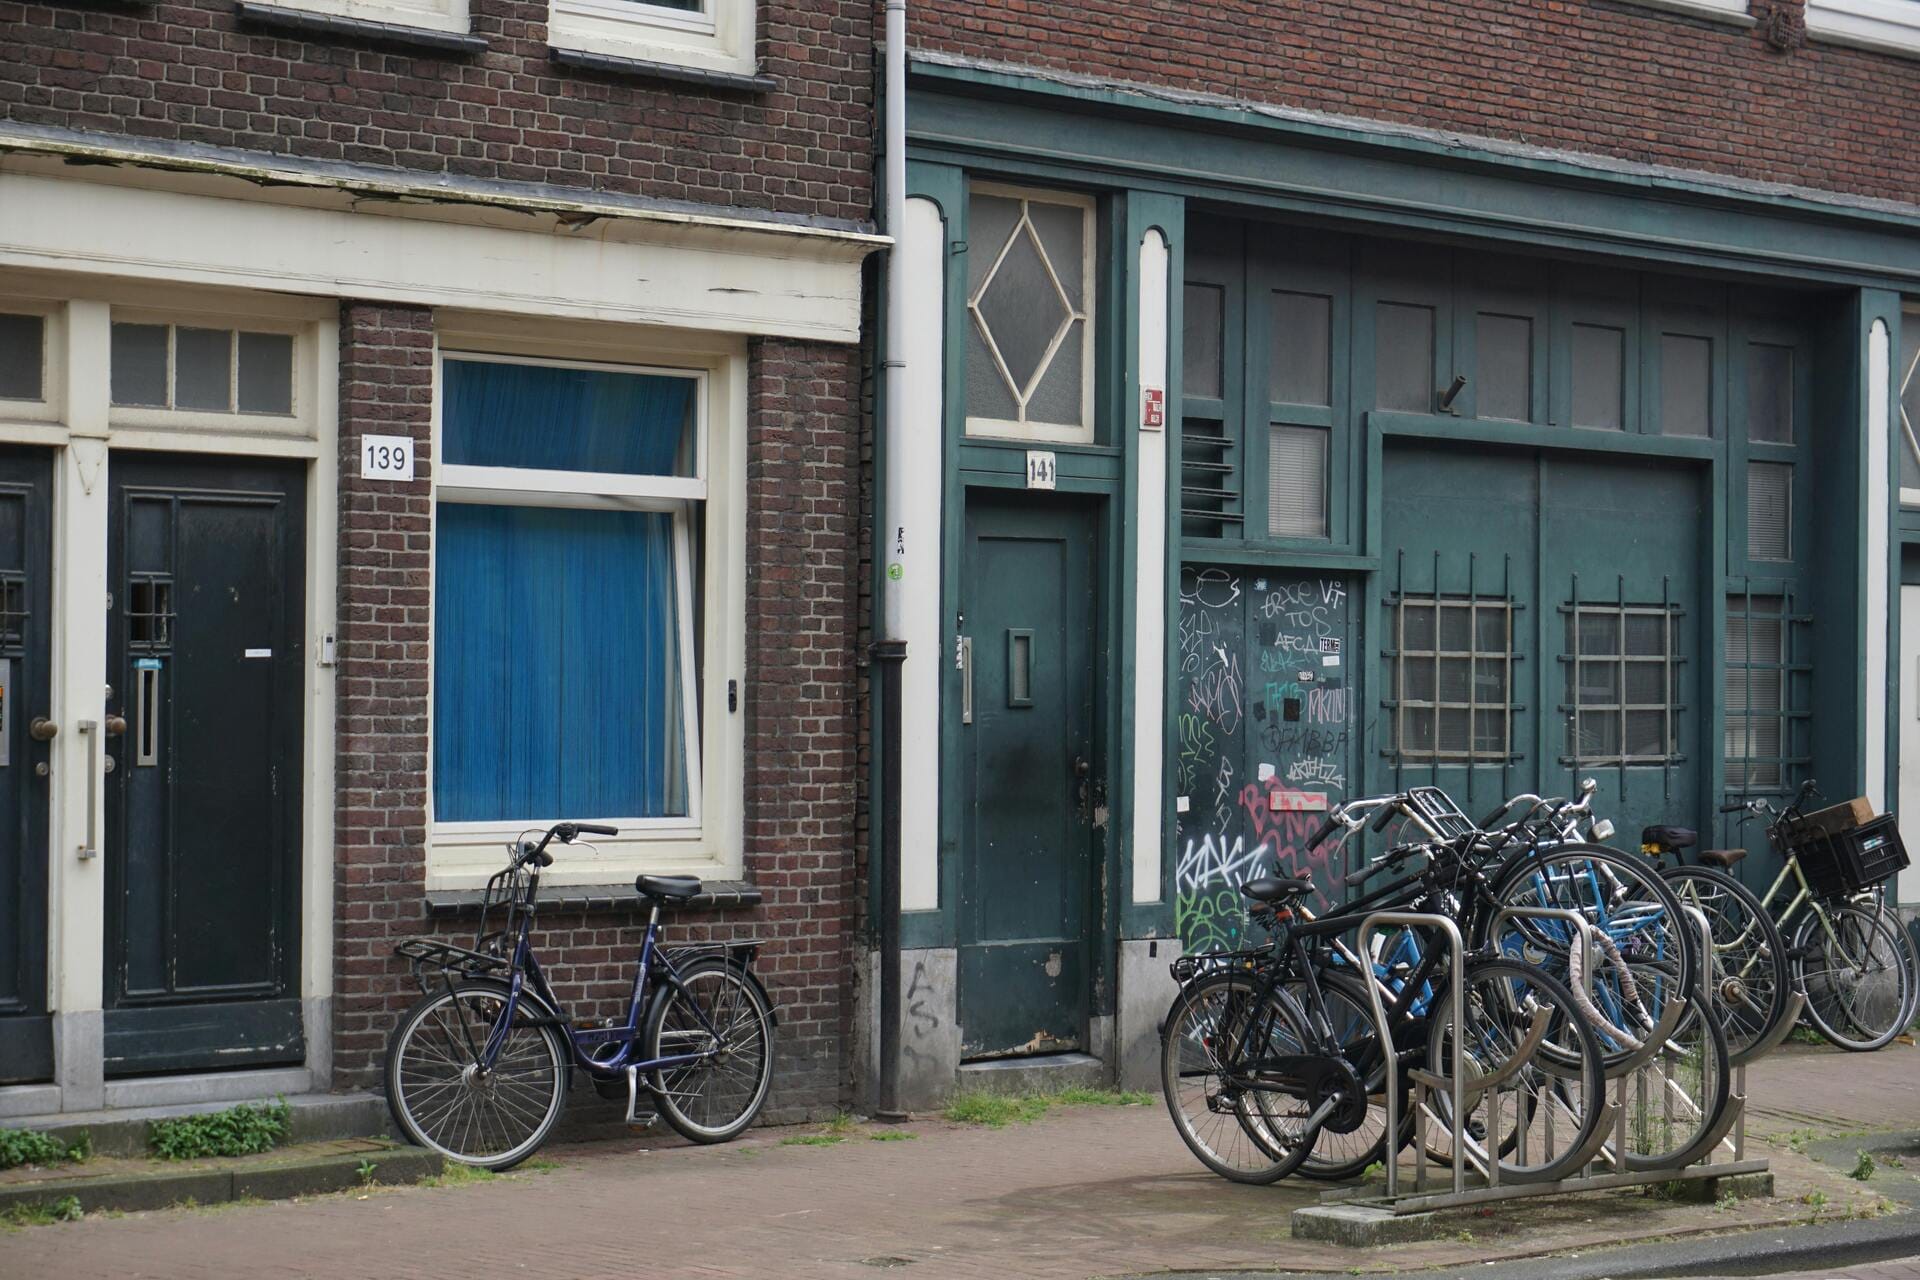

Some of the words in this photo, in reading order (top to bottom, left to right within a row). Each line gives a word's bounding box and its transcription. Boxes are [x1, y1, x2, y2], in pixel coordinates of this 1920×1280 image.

[368, 445, 405, 470] 139
[1030, 458, 1054, 482] 141
[1274, 631, 1320, 655] AFCA
